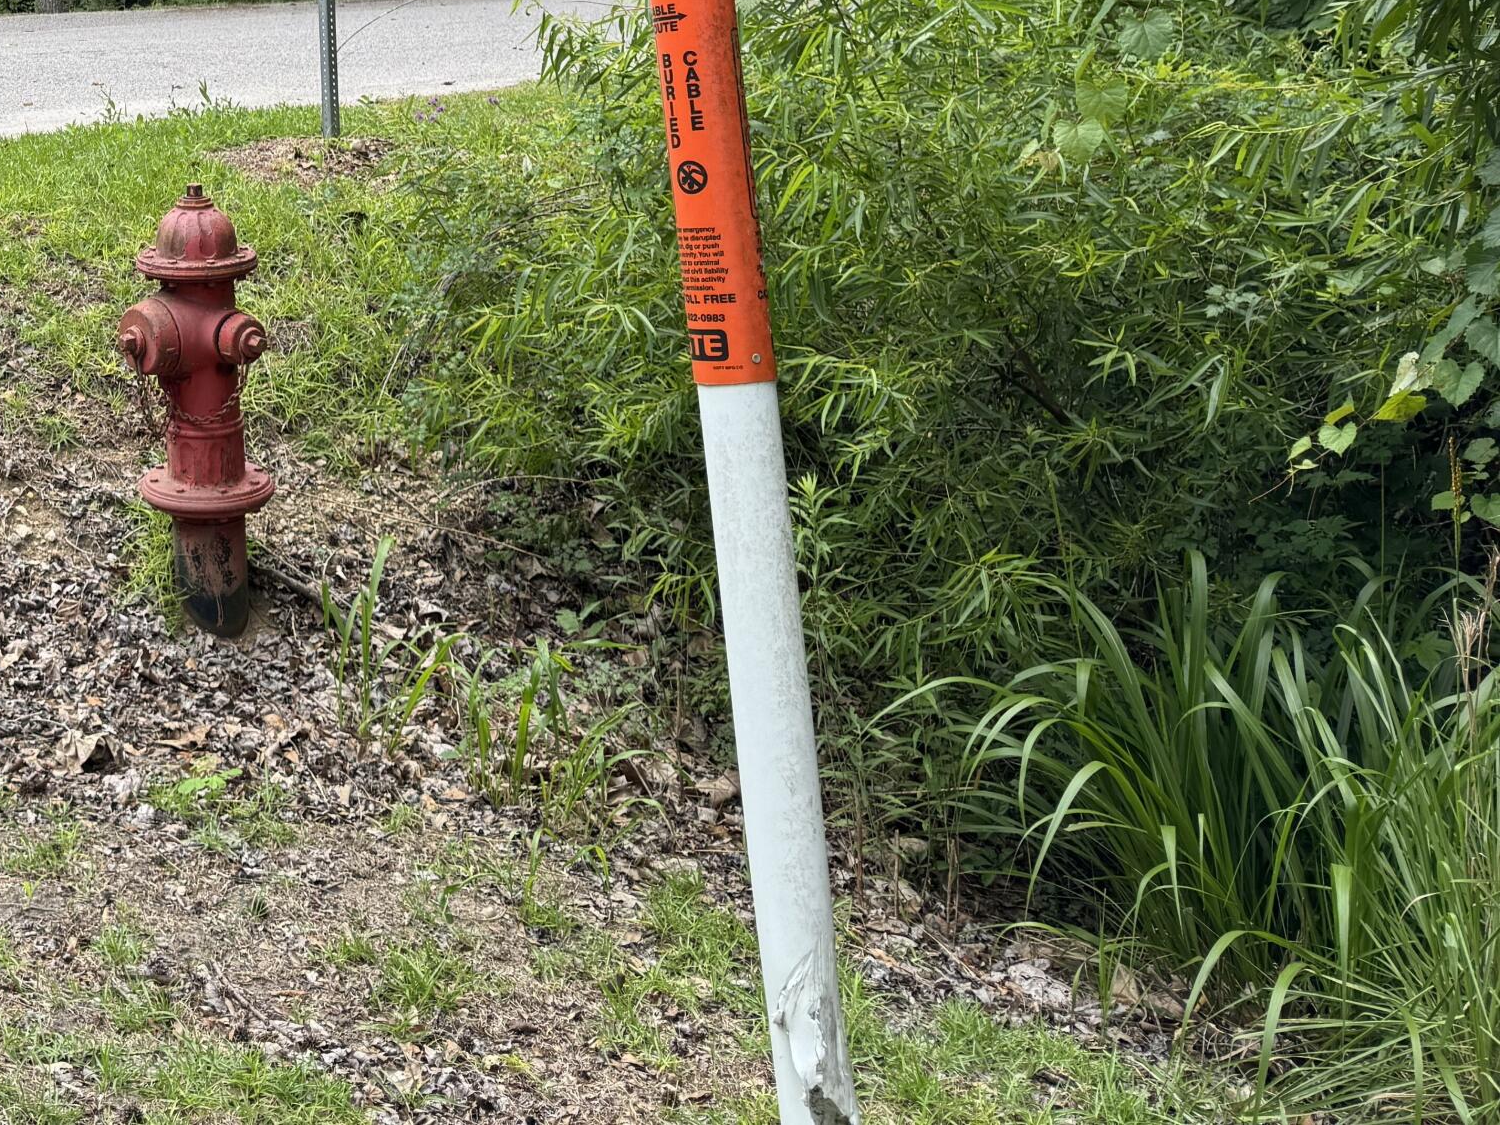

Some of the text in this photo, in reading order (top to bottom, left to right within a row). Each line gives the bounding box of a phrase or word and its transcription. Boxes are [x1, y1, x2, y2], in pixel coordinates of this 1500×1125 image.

[662, 53, 681, 149] BURIED
[682, 50, 704, 131] CABLE
[704, 293, 736, 304] FREE
